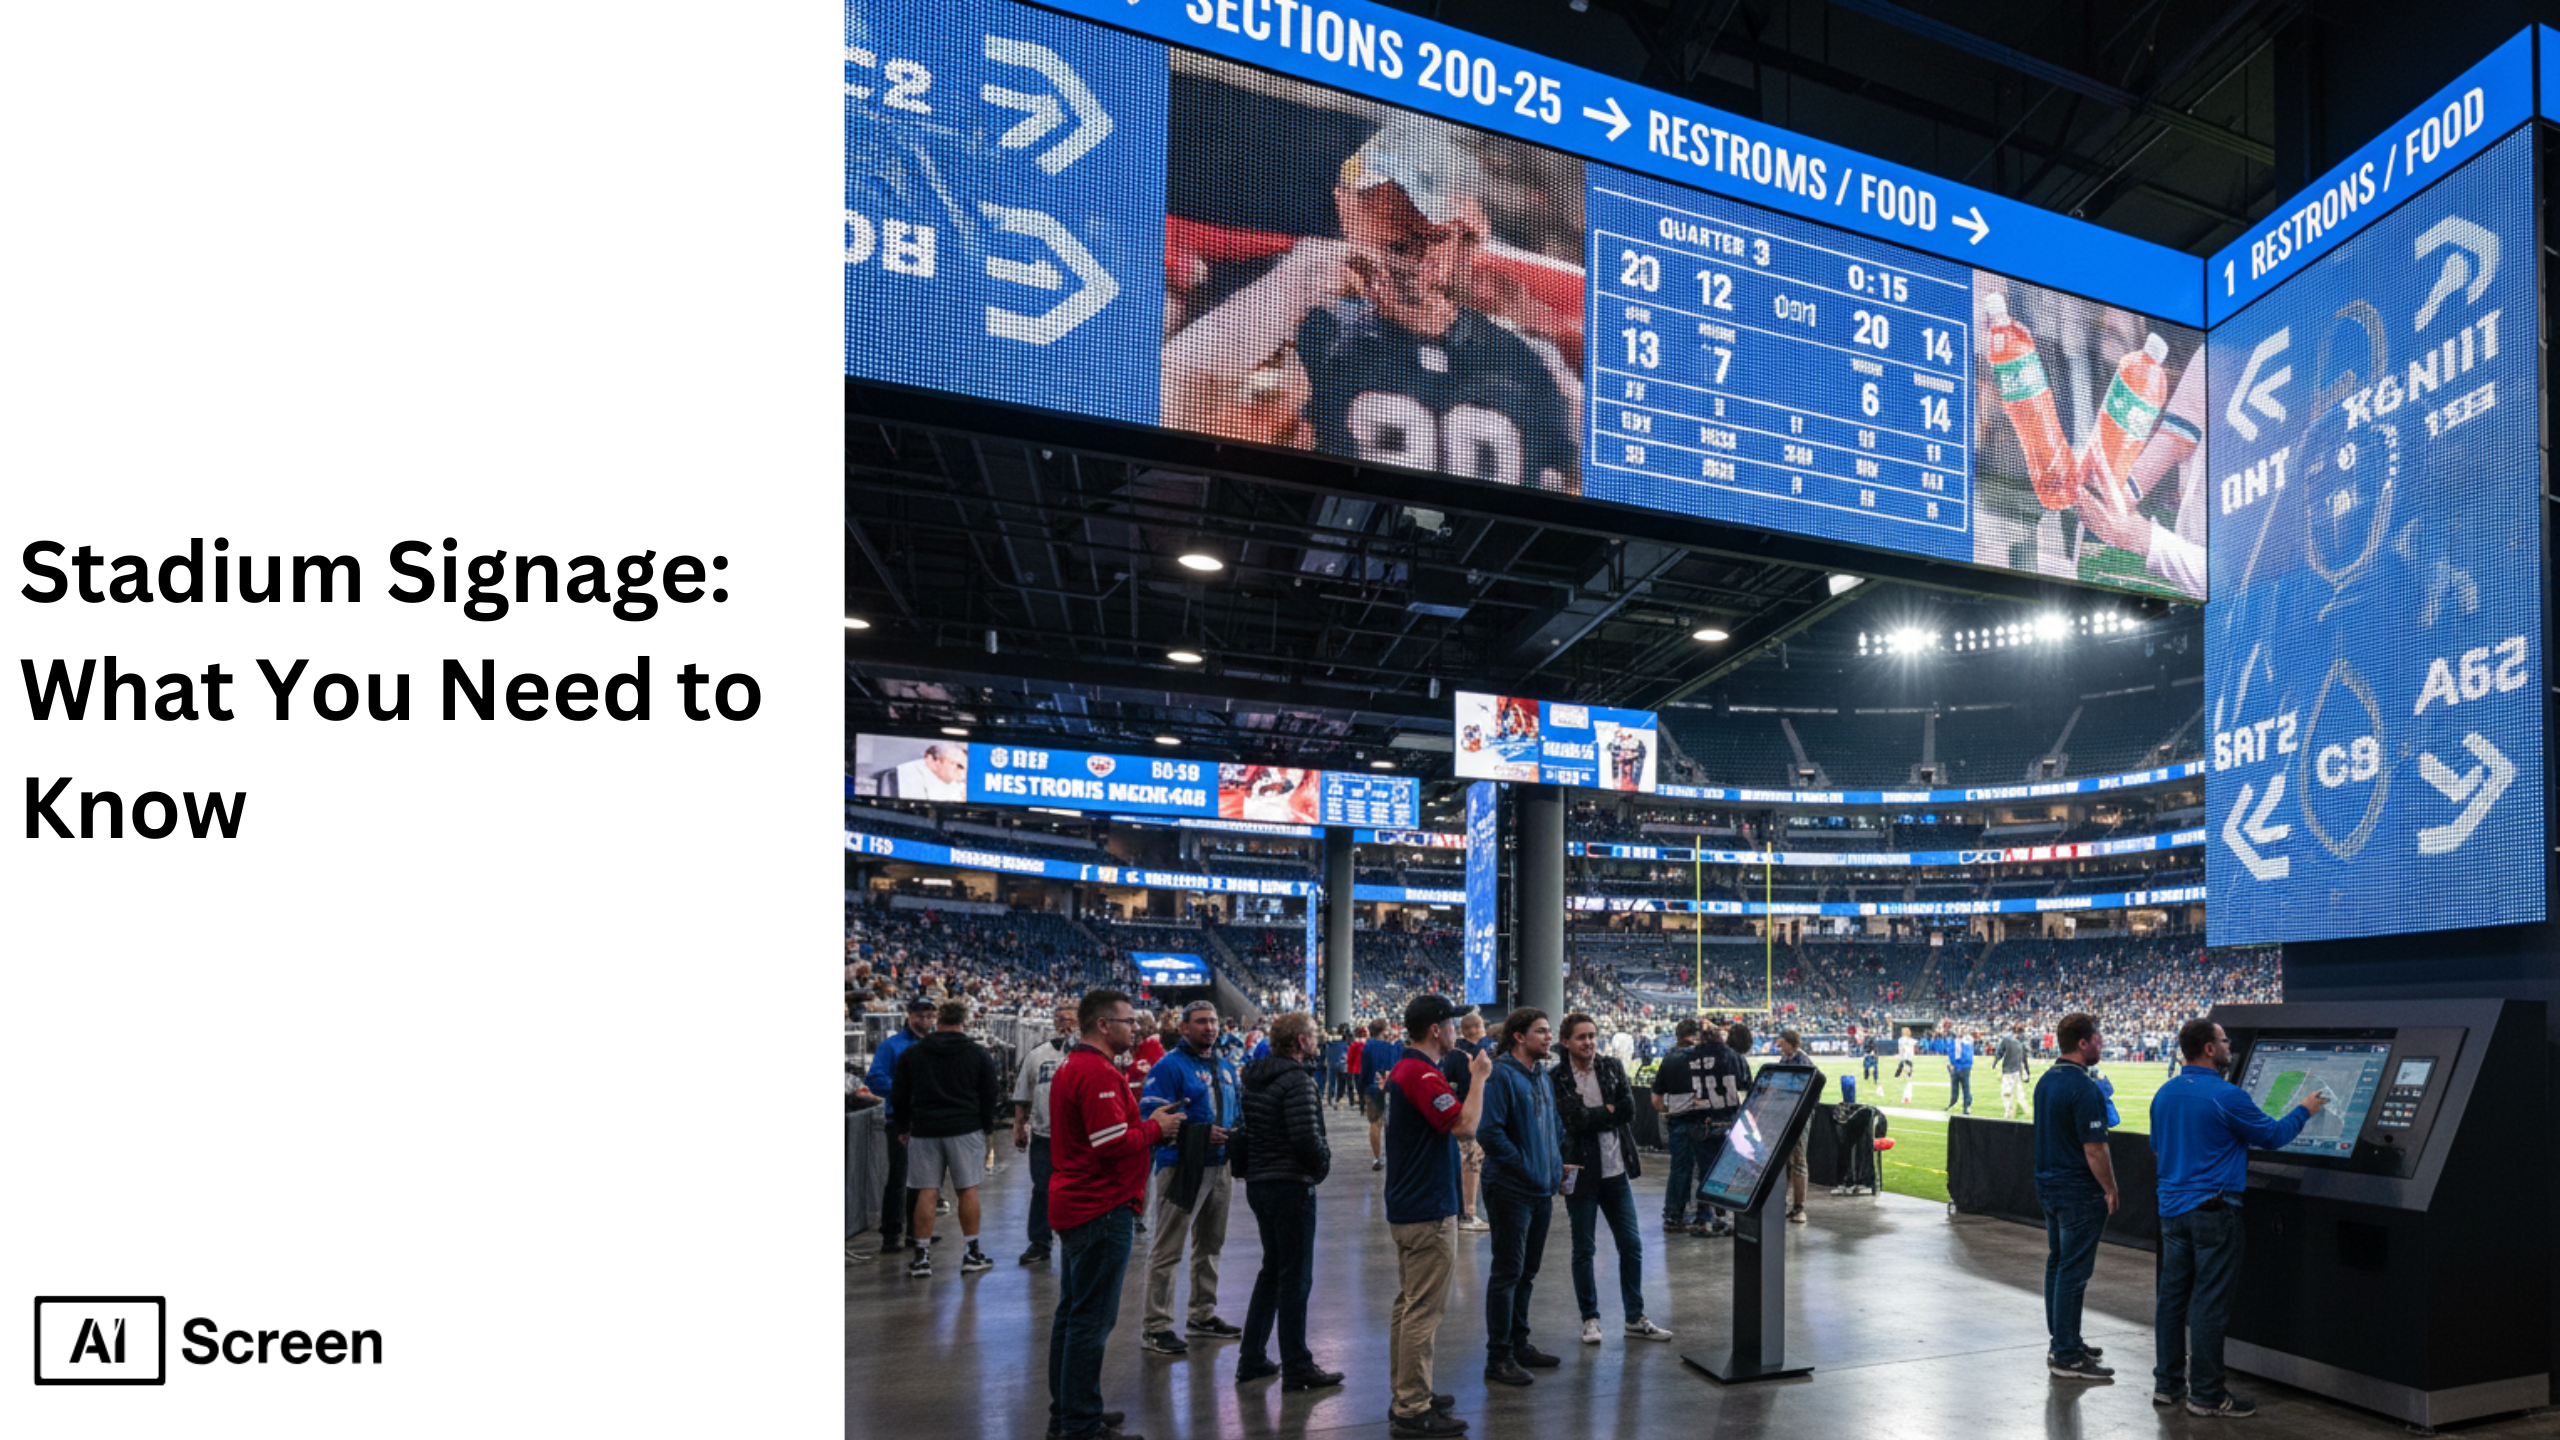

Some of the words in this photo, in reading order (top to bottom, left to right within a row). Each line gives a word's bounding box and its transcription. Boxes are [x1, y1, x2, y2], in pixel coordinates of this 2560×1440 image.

[1417, 42, 1562, 125] 200-25
[1648, 108, 1828, 202] RESTROMS
[1834, 167, 1853, 207] /
[1860, 172, 1937, 232] FOOD
[2223, 259, 2235, 298] 1
[2251, 161, 2376, 281] RESTRONS
[2382, 143, 2397, 193] /
[2405, 86, 2485, 177] FOOD
[1659, 217, 1745, 257] QUARTER
[1752, 238, 1771, 266] 3
[1620, 249, 1660, 292] 20
[1696, 269, 1733, 312] 12
[1847, 264, 1908, 303] 0:15
[1621, 327, 1660, 369] 13
[1711, 347, 1732, 384] 7
[1852, 310, 1890, 350] 20
[1920, 327, 1953, 366] 14
[1861, 381, 1880, 417] 6
[1919, 394, 1952, 433] 14
